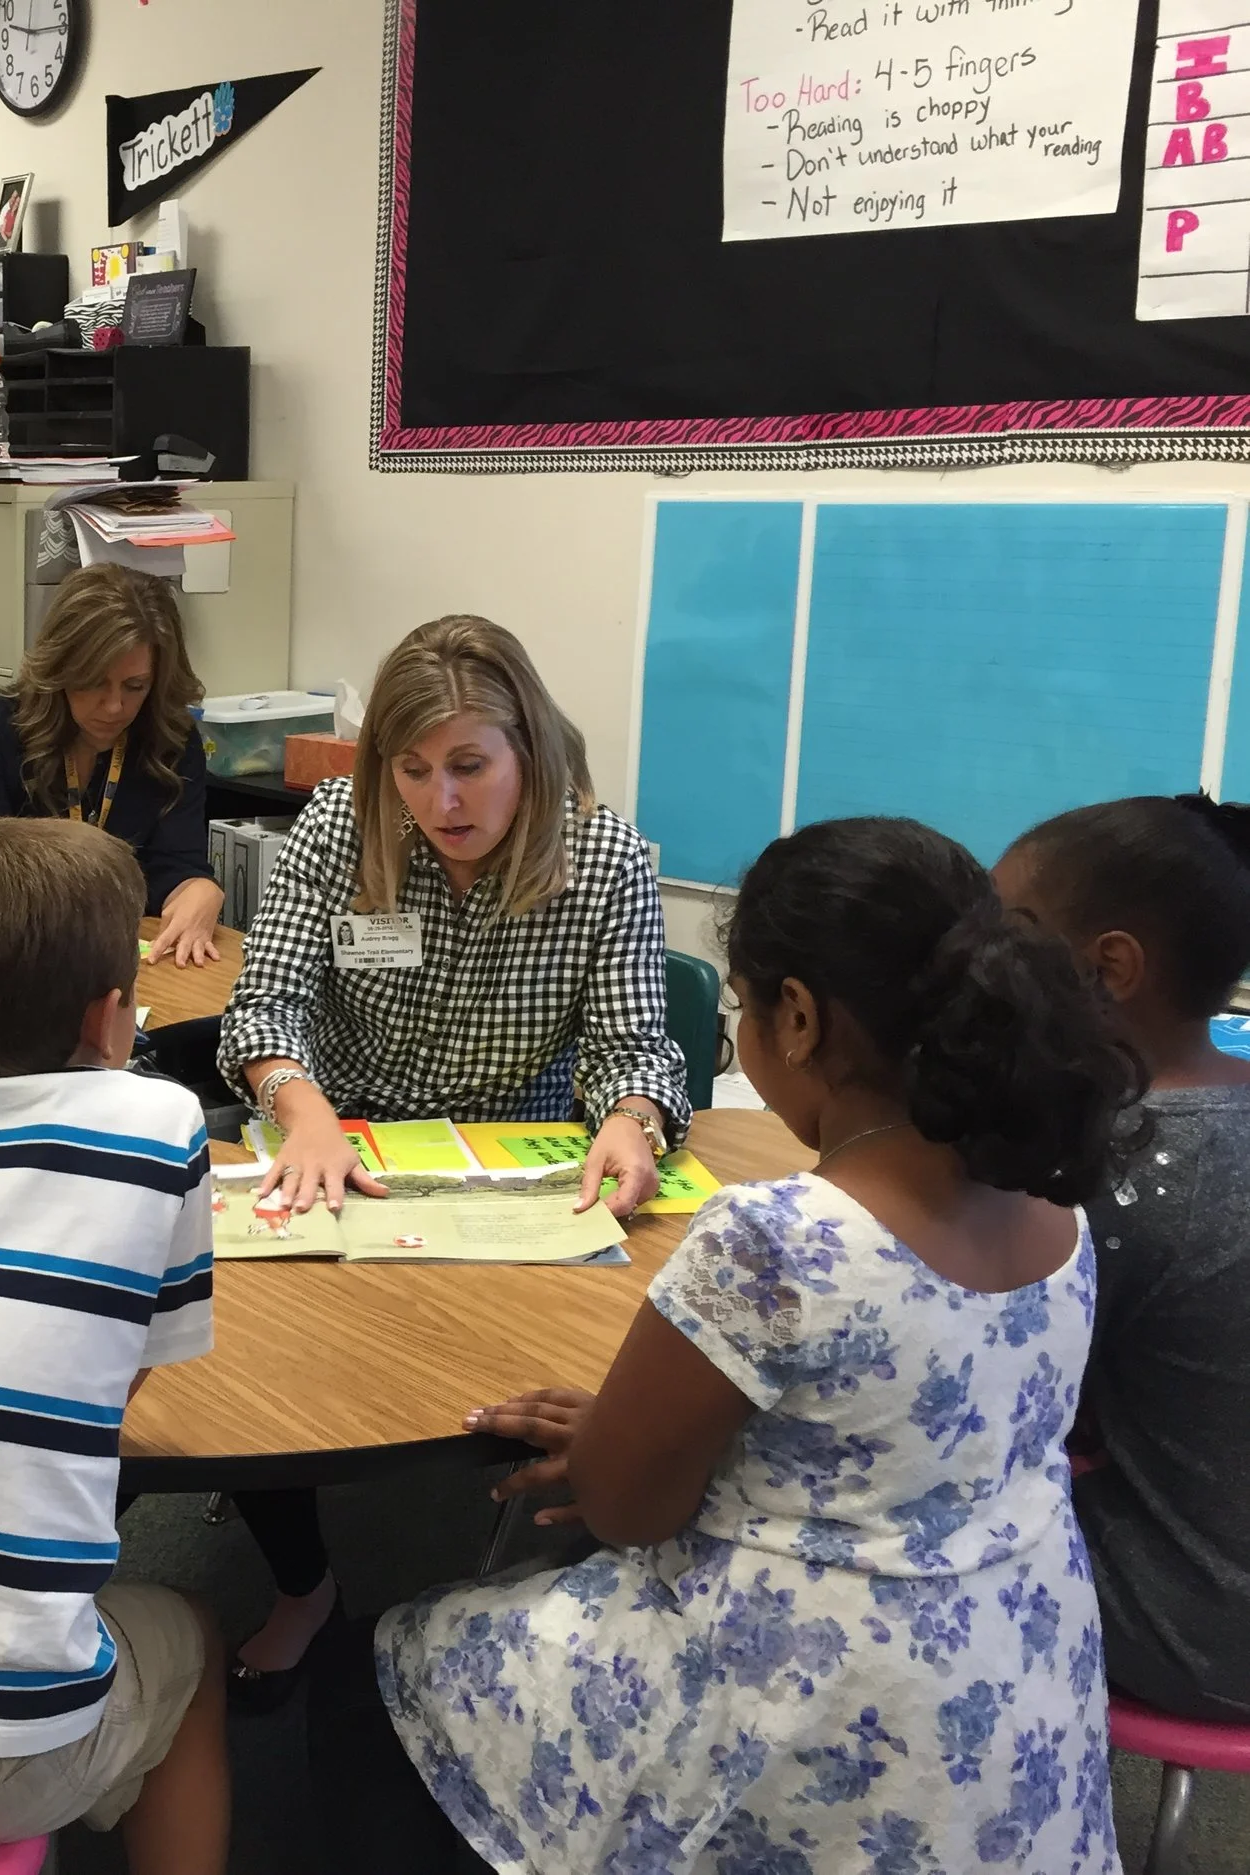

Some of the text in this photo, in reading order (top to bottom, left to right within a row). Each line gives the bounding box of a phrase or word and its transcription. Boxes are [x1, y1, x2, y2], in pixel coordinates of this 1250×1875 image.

[1, 28, 9, 50] 9
[58, 12, 67, 36] 3
[808, 9, 868, 42] Read
[884, 3, 902, 26] it
[6, 54, 14, 76] 8
[55, 41, 63, 64] 4
[16, 72, 24, 94] 7
[30, 75, 39, 98] 6
[44, 64, 54, 87] 5
[741, 45, 1036, 113] Too Hard: 4-5 fingers
[782, 96, 991, 145] Reading is choppy
[1176, 81, 1211, 121] B
[122, 99, 212, 183] Trickett
[786, 120, 1072, 181] Don't understand what your
[1044, 137, 1101, 165] reading
[1162, 123, 1228, 168] AB
[786, 177, 958, 222] Not enjoying it
[1166, 210, 1199, 252] P
